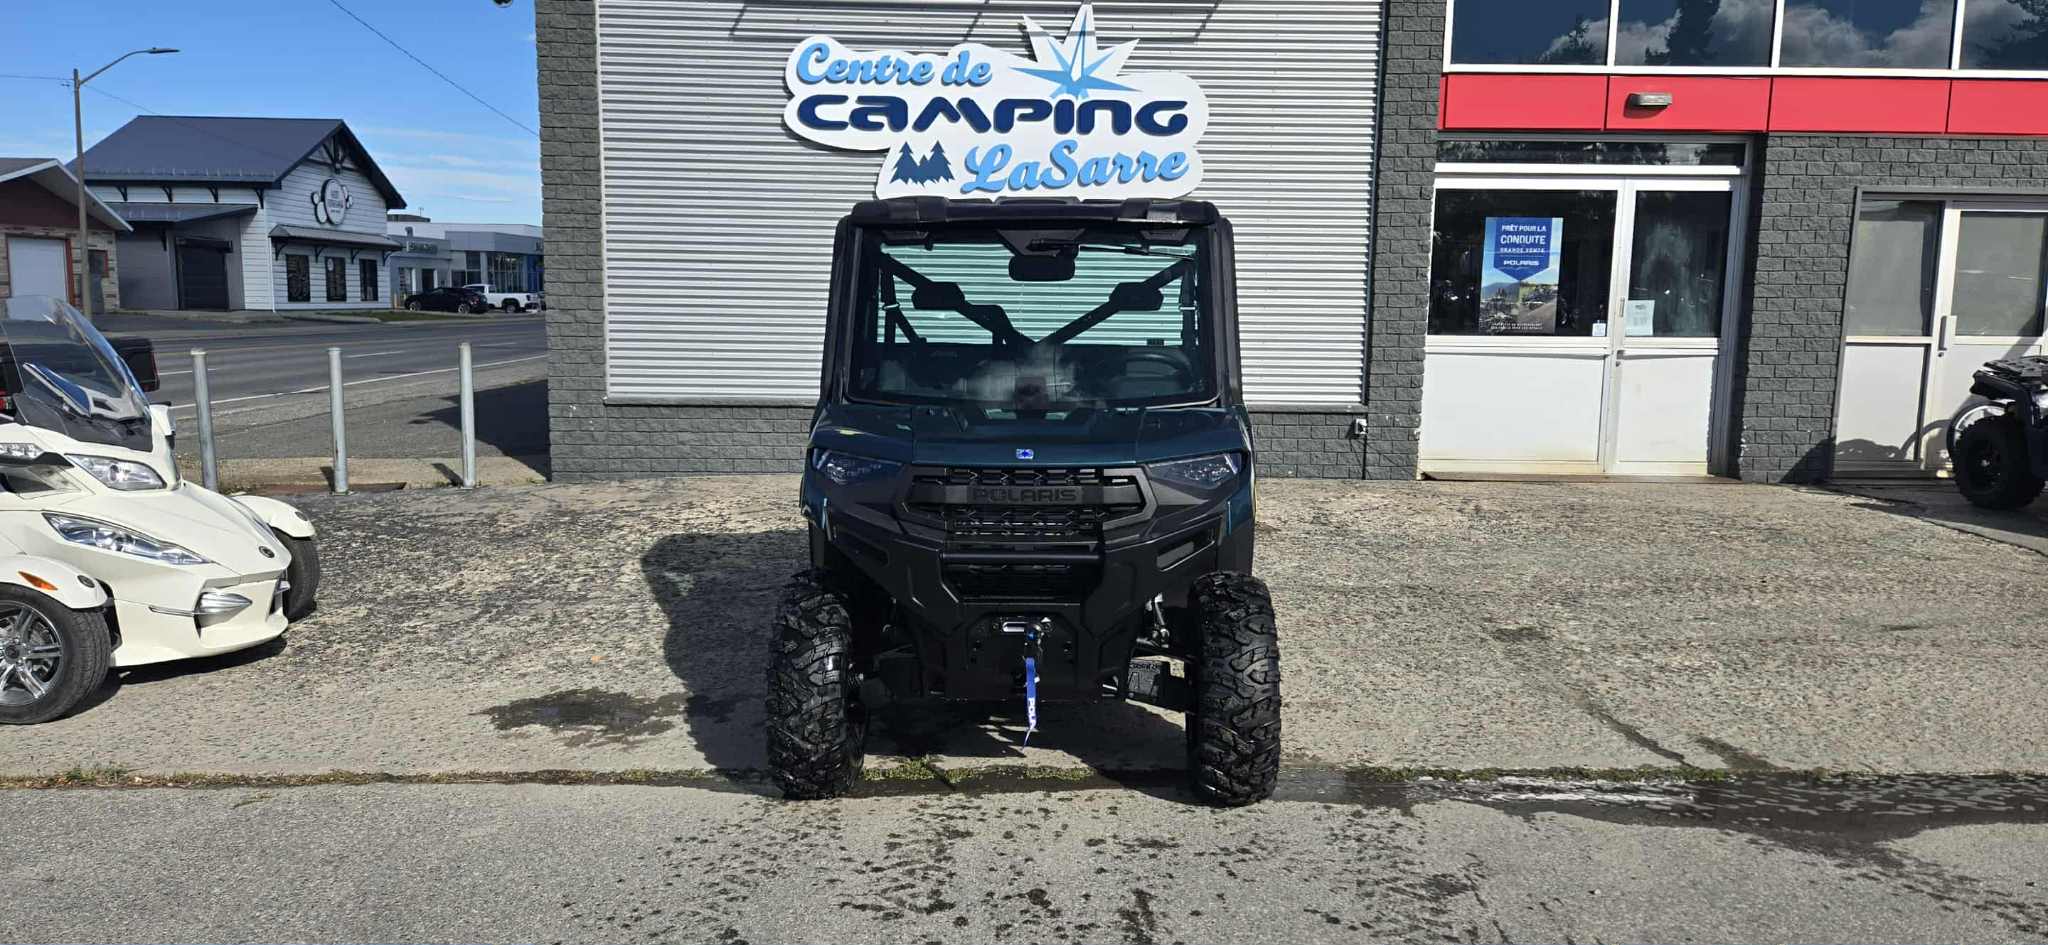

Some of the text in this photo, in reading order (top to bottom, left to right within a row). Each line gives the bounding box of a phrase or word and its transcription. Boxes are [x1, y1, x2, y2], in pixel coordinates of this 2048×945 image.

[796, 42, 993, 88] Centre de
[797, 94, 1189, 137] CAMPING
[960, 139, 1190, 194] LaSarre
[1500, 234, 1546, 245] CONDUITE
[972, 488, 1077, 502] POLARIS
